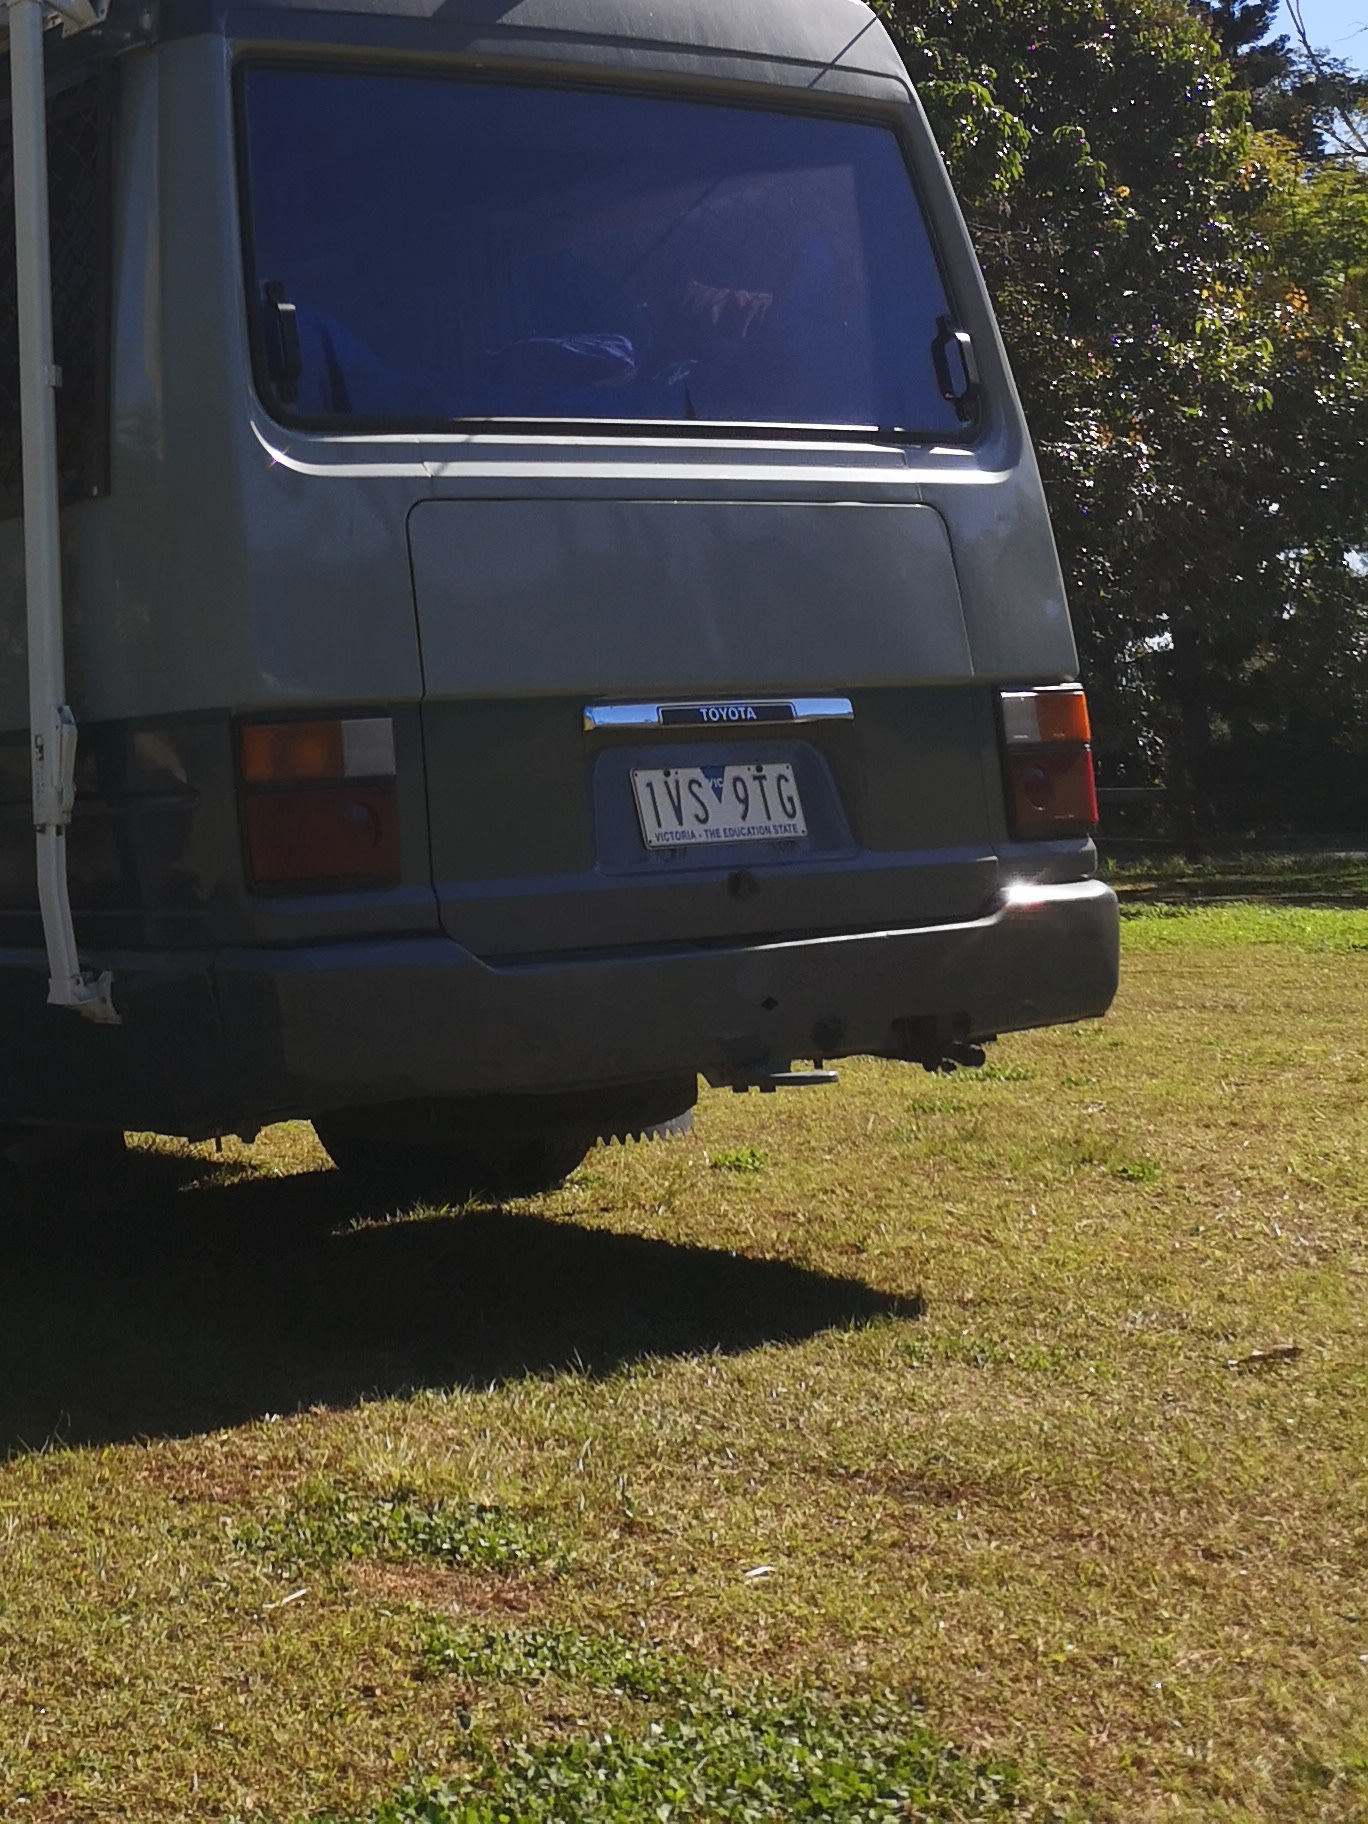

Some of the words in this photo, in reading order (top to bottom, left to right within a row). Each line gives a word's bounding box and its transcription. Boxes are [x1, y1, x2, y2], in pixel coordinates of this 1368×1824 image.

[699, 706, 757, 722] TOYOTA
[645, 778, 709, 828] 1VS
[733, 774, 797, 822] 9TG
[654, 830, 696, 842] VICTORIA
[704, 828, 721, 839] THE
[723, 826, 772, 838] EDUCATION
[774, 824, 799, 835] STATE
